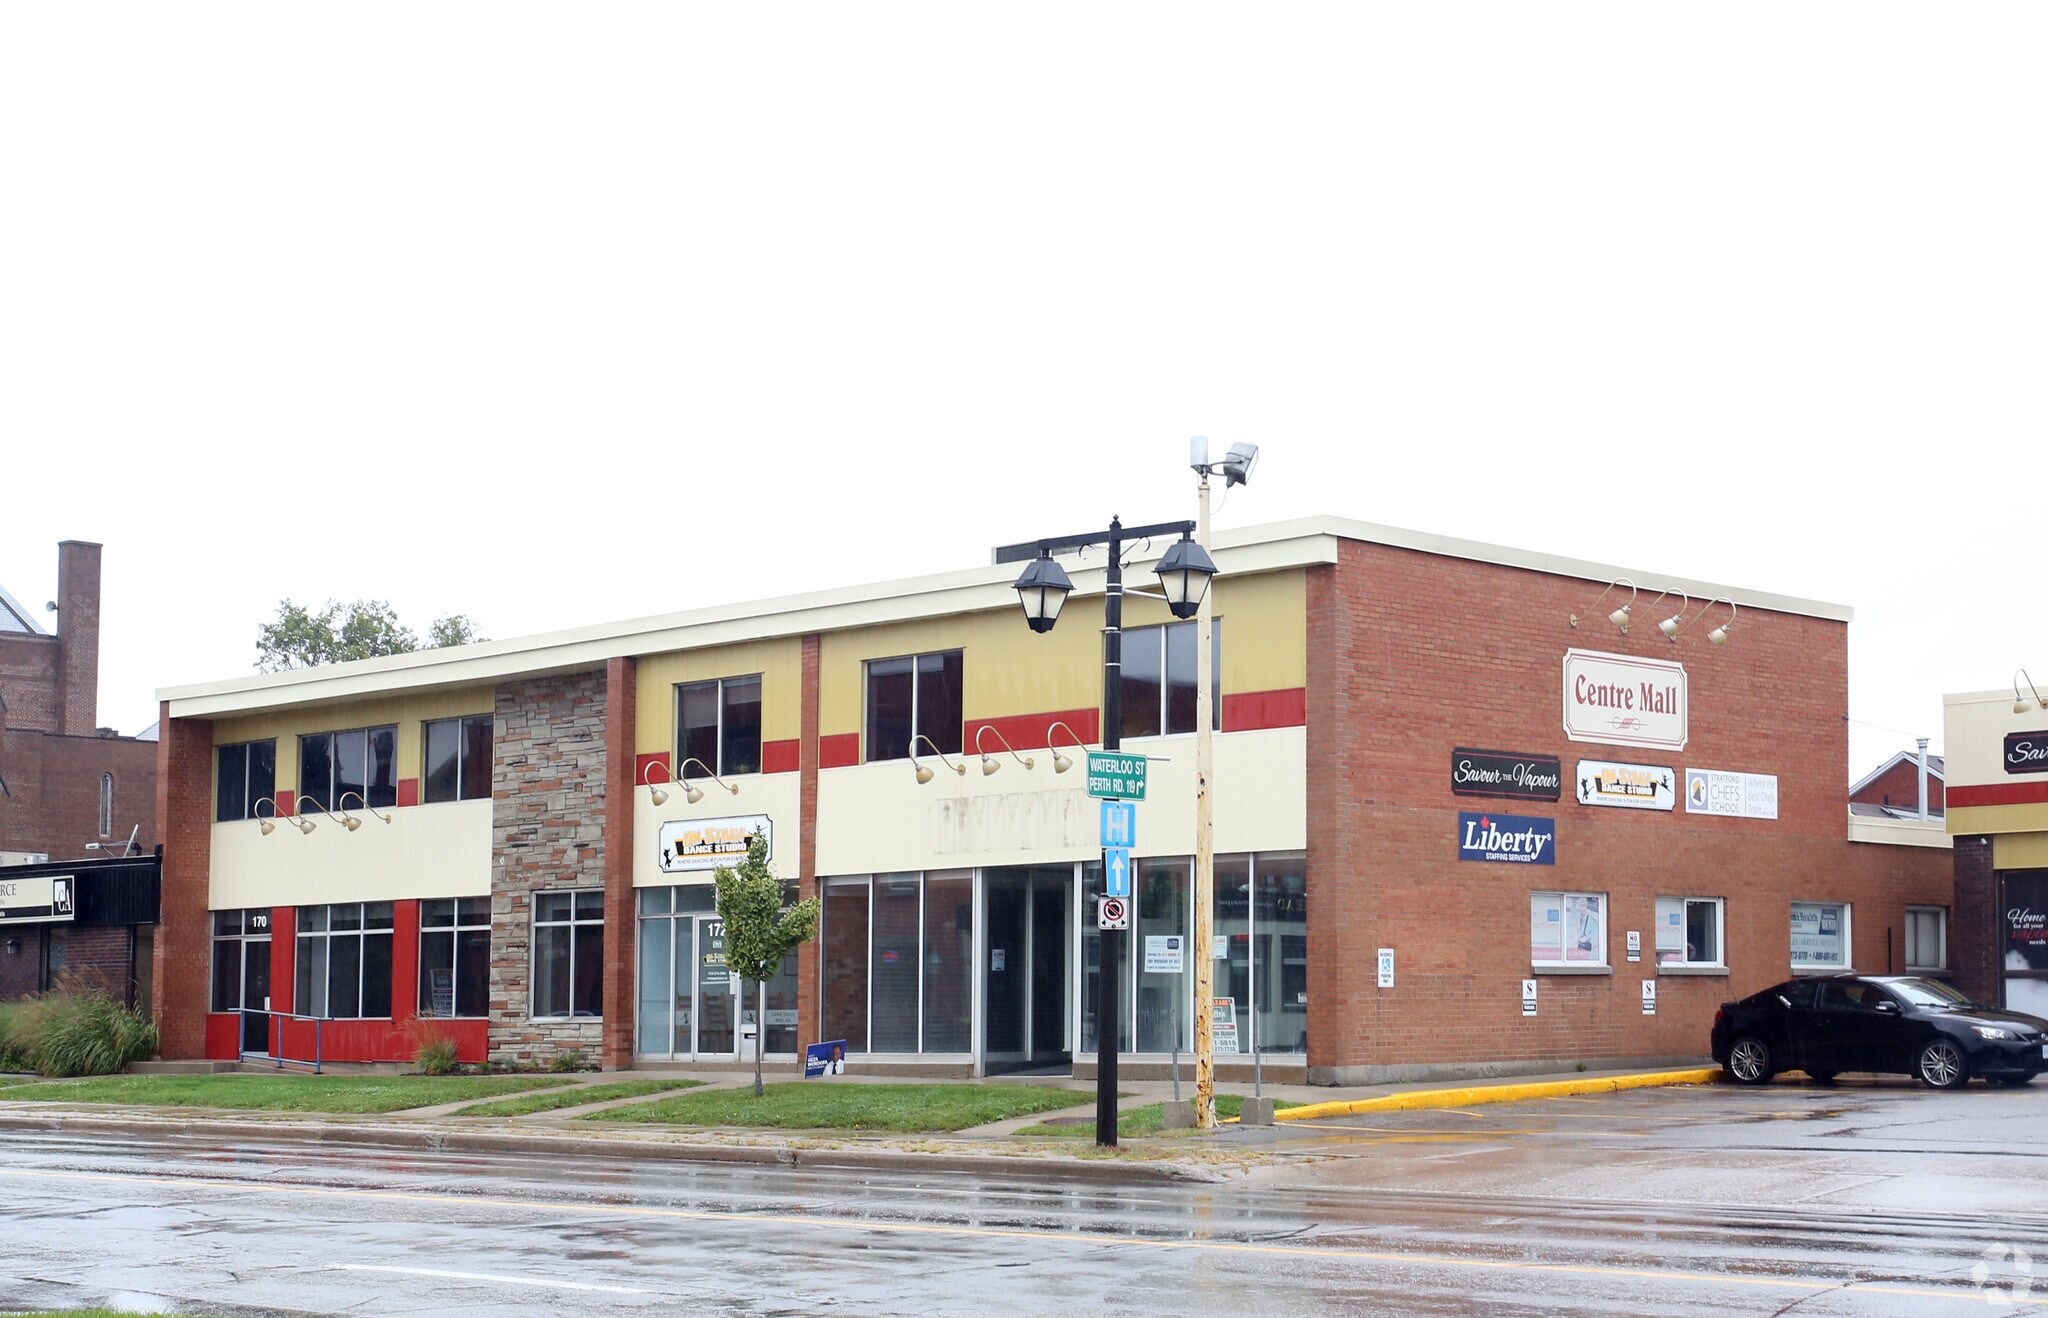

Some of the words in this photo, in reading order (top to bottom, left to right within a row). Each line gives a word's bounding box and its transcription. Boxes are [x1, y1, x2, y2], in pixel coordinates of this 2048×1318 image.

[1575, 673, 1634, 711] Centre
[1639, 682, 1678, 715] Mall
[1089, 758, 1132, 774] WATERLOO
[1135, 761, 1145, 775] ST
[1453, 760, 1502, 783] Savour
[1502, 773, 1512, 781] THE
[1512, 763, 1559, 791] Vapour
[1711, 774, 1739, 783] STRATFORD
[1089, 777, 1111, 792] PERTH
[1113, 779, 1124, 793] RD.
[1126, 780, 1135, 794] 119
[1602, 784, 1626, 795] DANCE
[1627, 786, 1653, 797] STUDIO
[1710, 784, 1740, 801] CHEFS
[1711, 802, 1740, 814] SCHOOL
[1107, 808, 1129, 841] H
[1463, 816, 1547, 860] Liberty
[683, 845, 713, 854] DANCE
[715, 843, 746, 853] STUDIO
[1486, 852, 1508, 861] STAFFING
[1509, 853, 1531, 862] SERVICES
[253, 916, 267, 927] 170
[2008, 908, 2046, 923] Home
